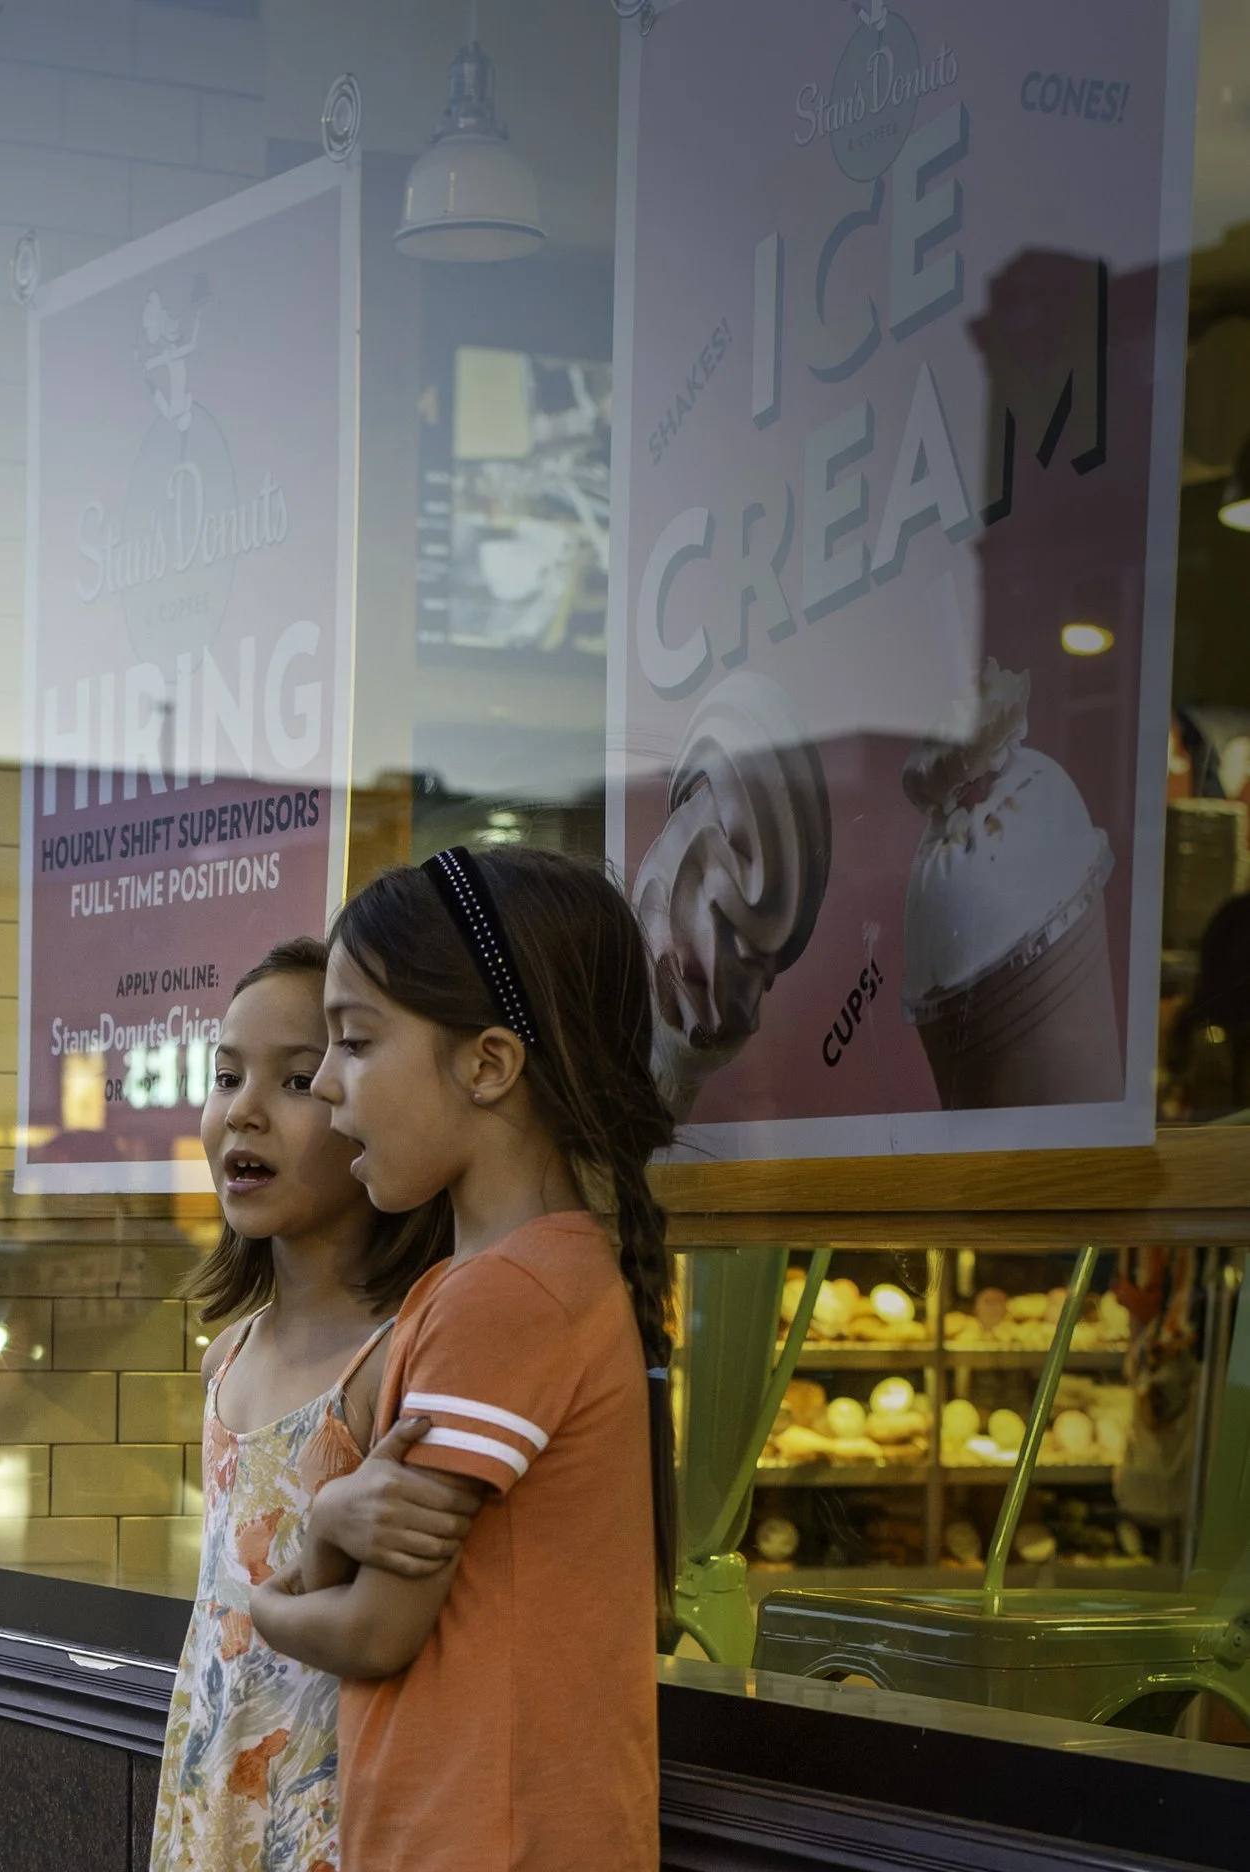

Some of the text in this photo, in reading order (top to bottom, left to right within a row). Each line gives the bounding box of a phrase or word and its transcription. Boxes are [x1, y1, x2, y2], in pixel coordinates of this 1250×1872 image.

[866, 41, 959, 114] Donuts
[1019, 70, 1132, 125] CONES!
[751, 100, 970, 432] ICE
[648, 316, 734, 466] SHAKES!
[165, 460, 289, 572] Donuts
[636, 255, 1108, 700] CREAM
[42, 620, 323, 817] HIRING
[41, 788, 320, 873] HOURLY SHIFT SUPERVISORS
[70, 851, 281, 918] FULL-TIME POSITIONS
[116, 963, 220, 999] APPLY ONLINE:
[822, 958, 884, 1068] CUPS!
[51, 1004, 223, 1057] StansDonutsChica
